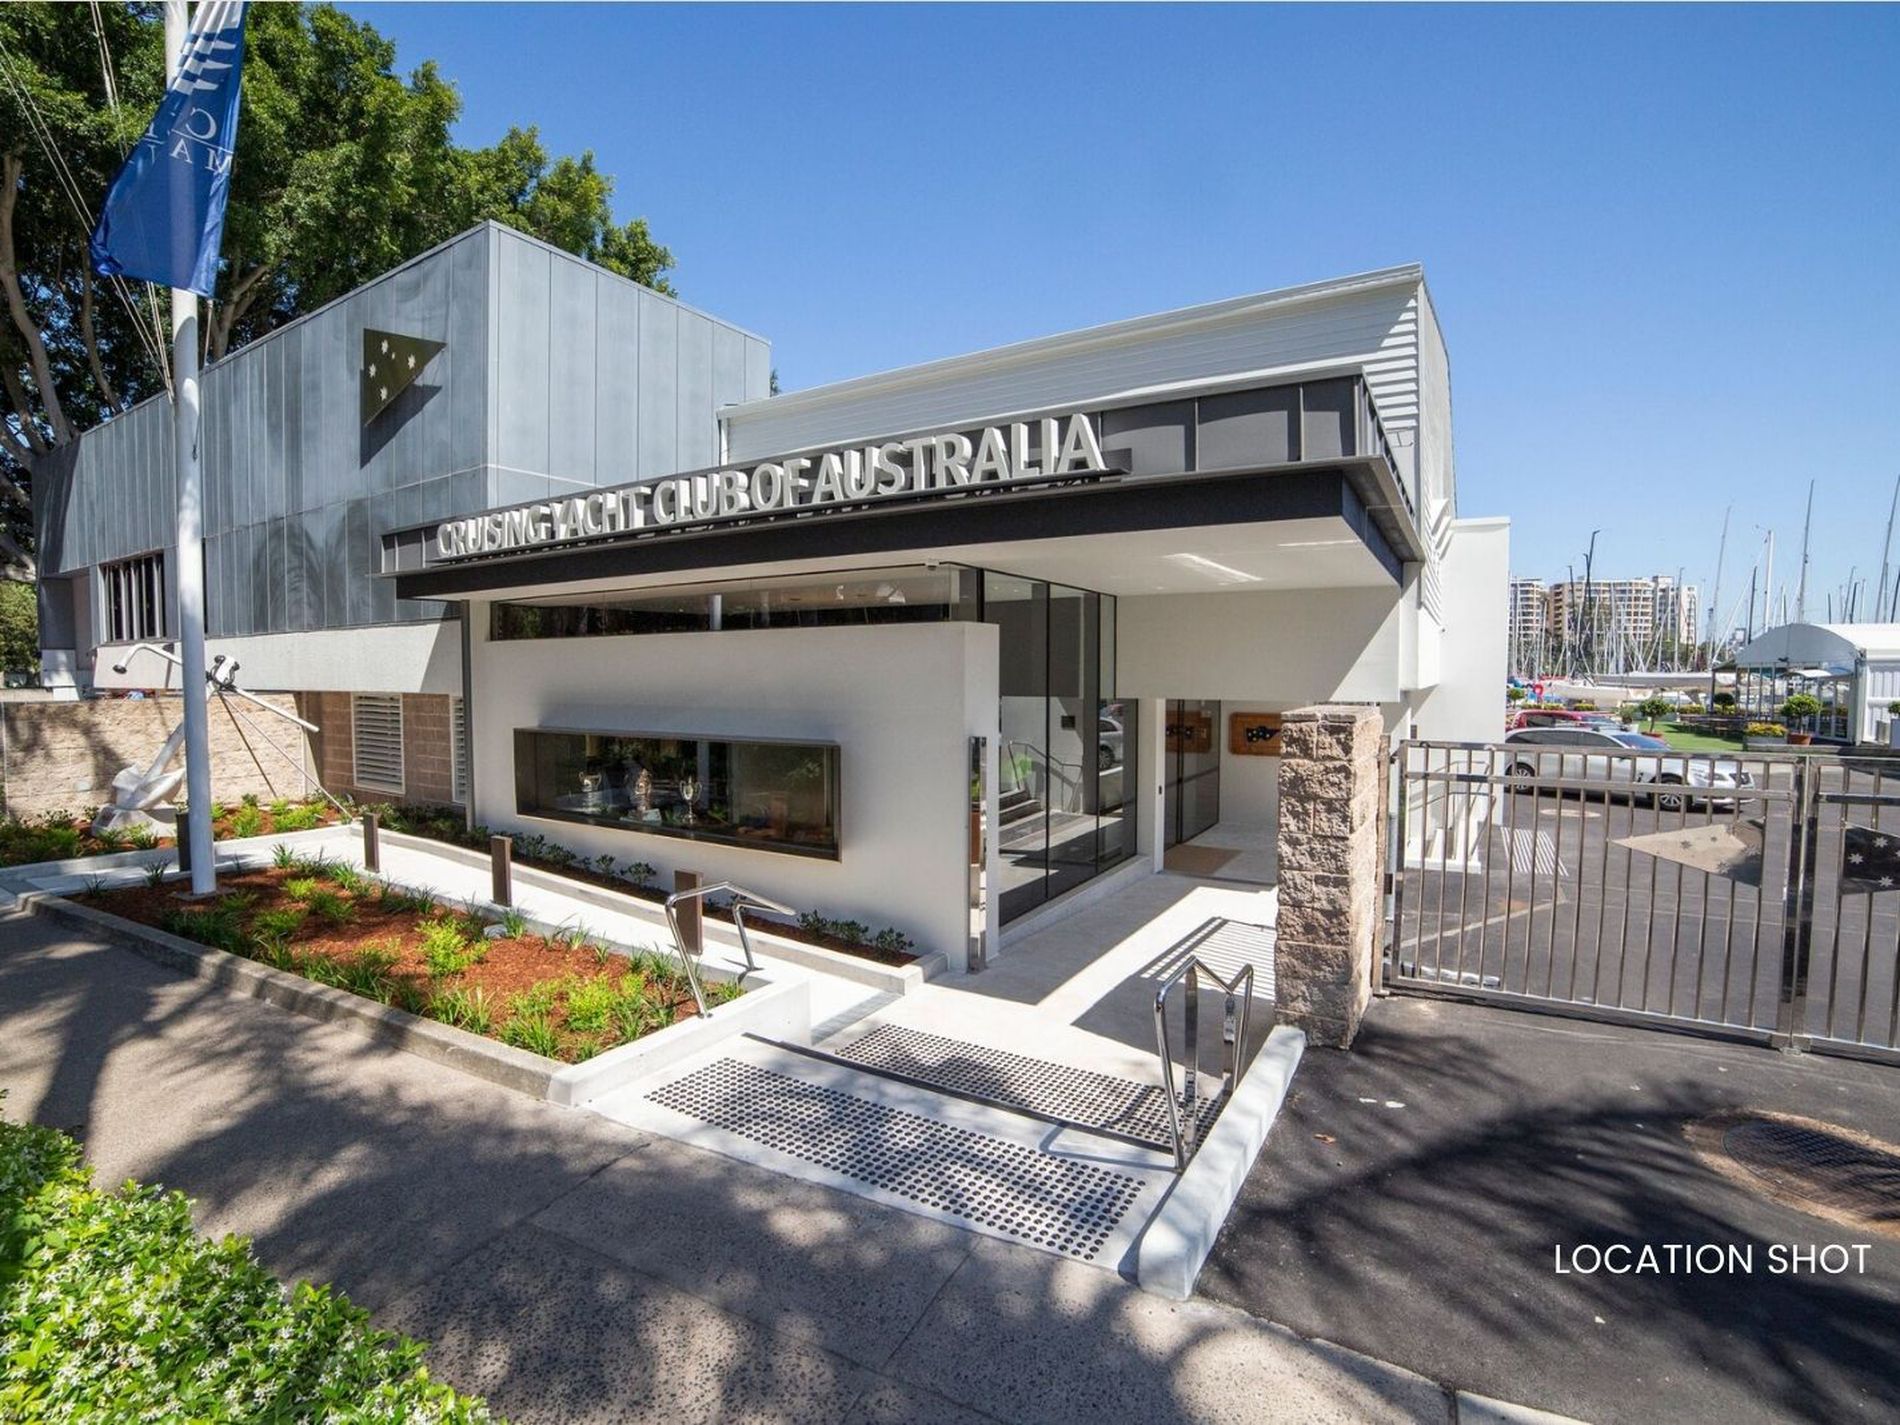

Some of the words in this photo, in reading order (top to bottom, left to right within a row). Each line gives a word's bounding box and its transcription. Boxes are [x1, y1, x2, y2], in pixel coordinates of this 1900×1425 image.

[436, 505, 551, 557] CRUISING
[550, 486, 651, 540] YACHT
[653, 470, 750, 525] CLUB
[751, 457, 811, 511] OF
[811, 413, 1109, 505] AUSTRALIA
